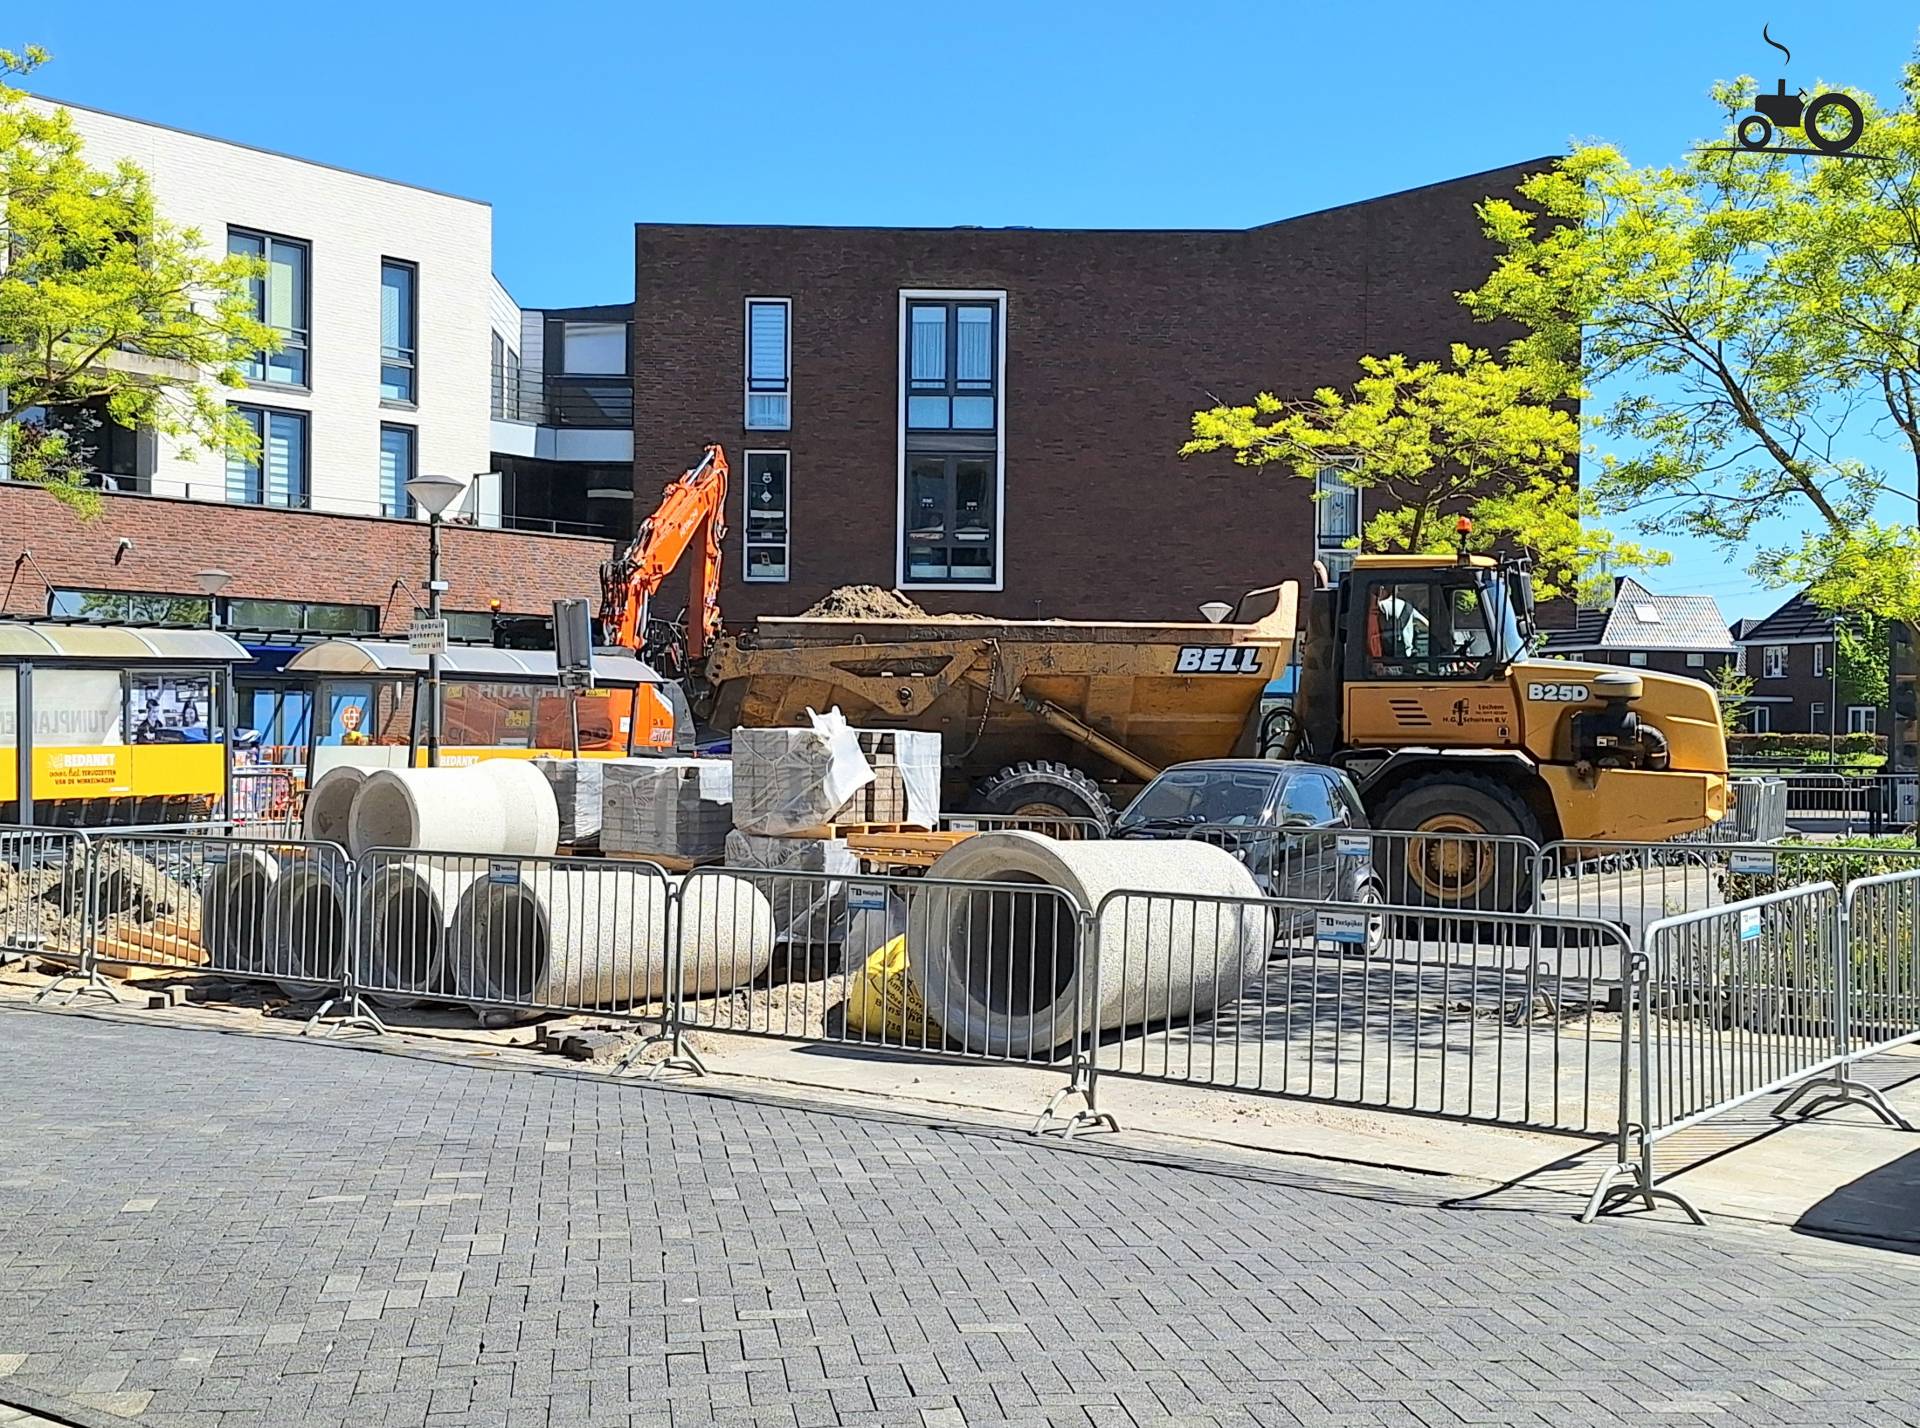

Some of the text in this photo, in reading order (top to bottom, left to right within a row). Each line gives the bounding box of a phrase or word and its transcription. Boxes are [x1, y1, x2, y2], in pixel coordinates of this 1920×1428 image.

[1175, 647, 1260, 672] BELL
[479, 685, 566, 698] HITACHI
[1528, 683, 1589, 701] B25D
[64, 753, 116, 768] BEDANKT
